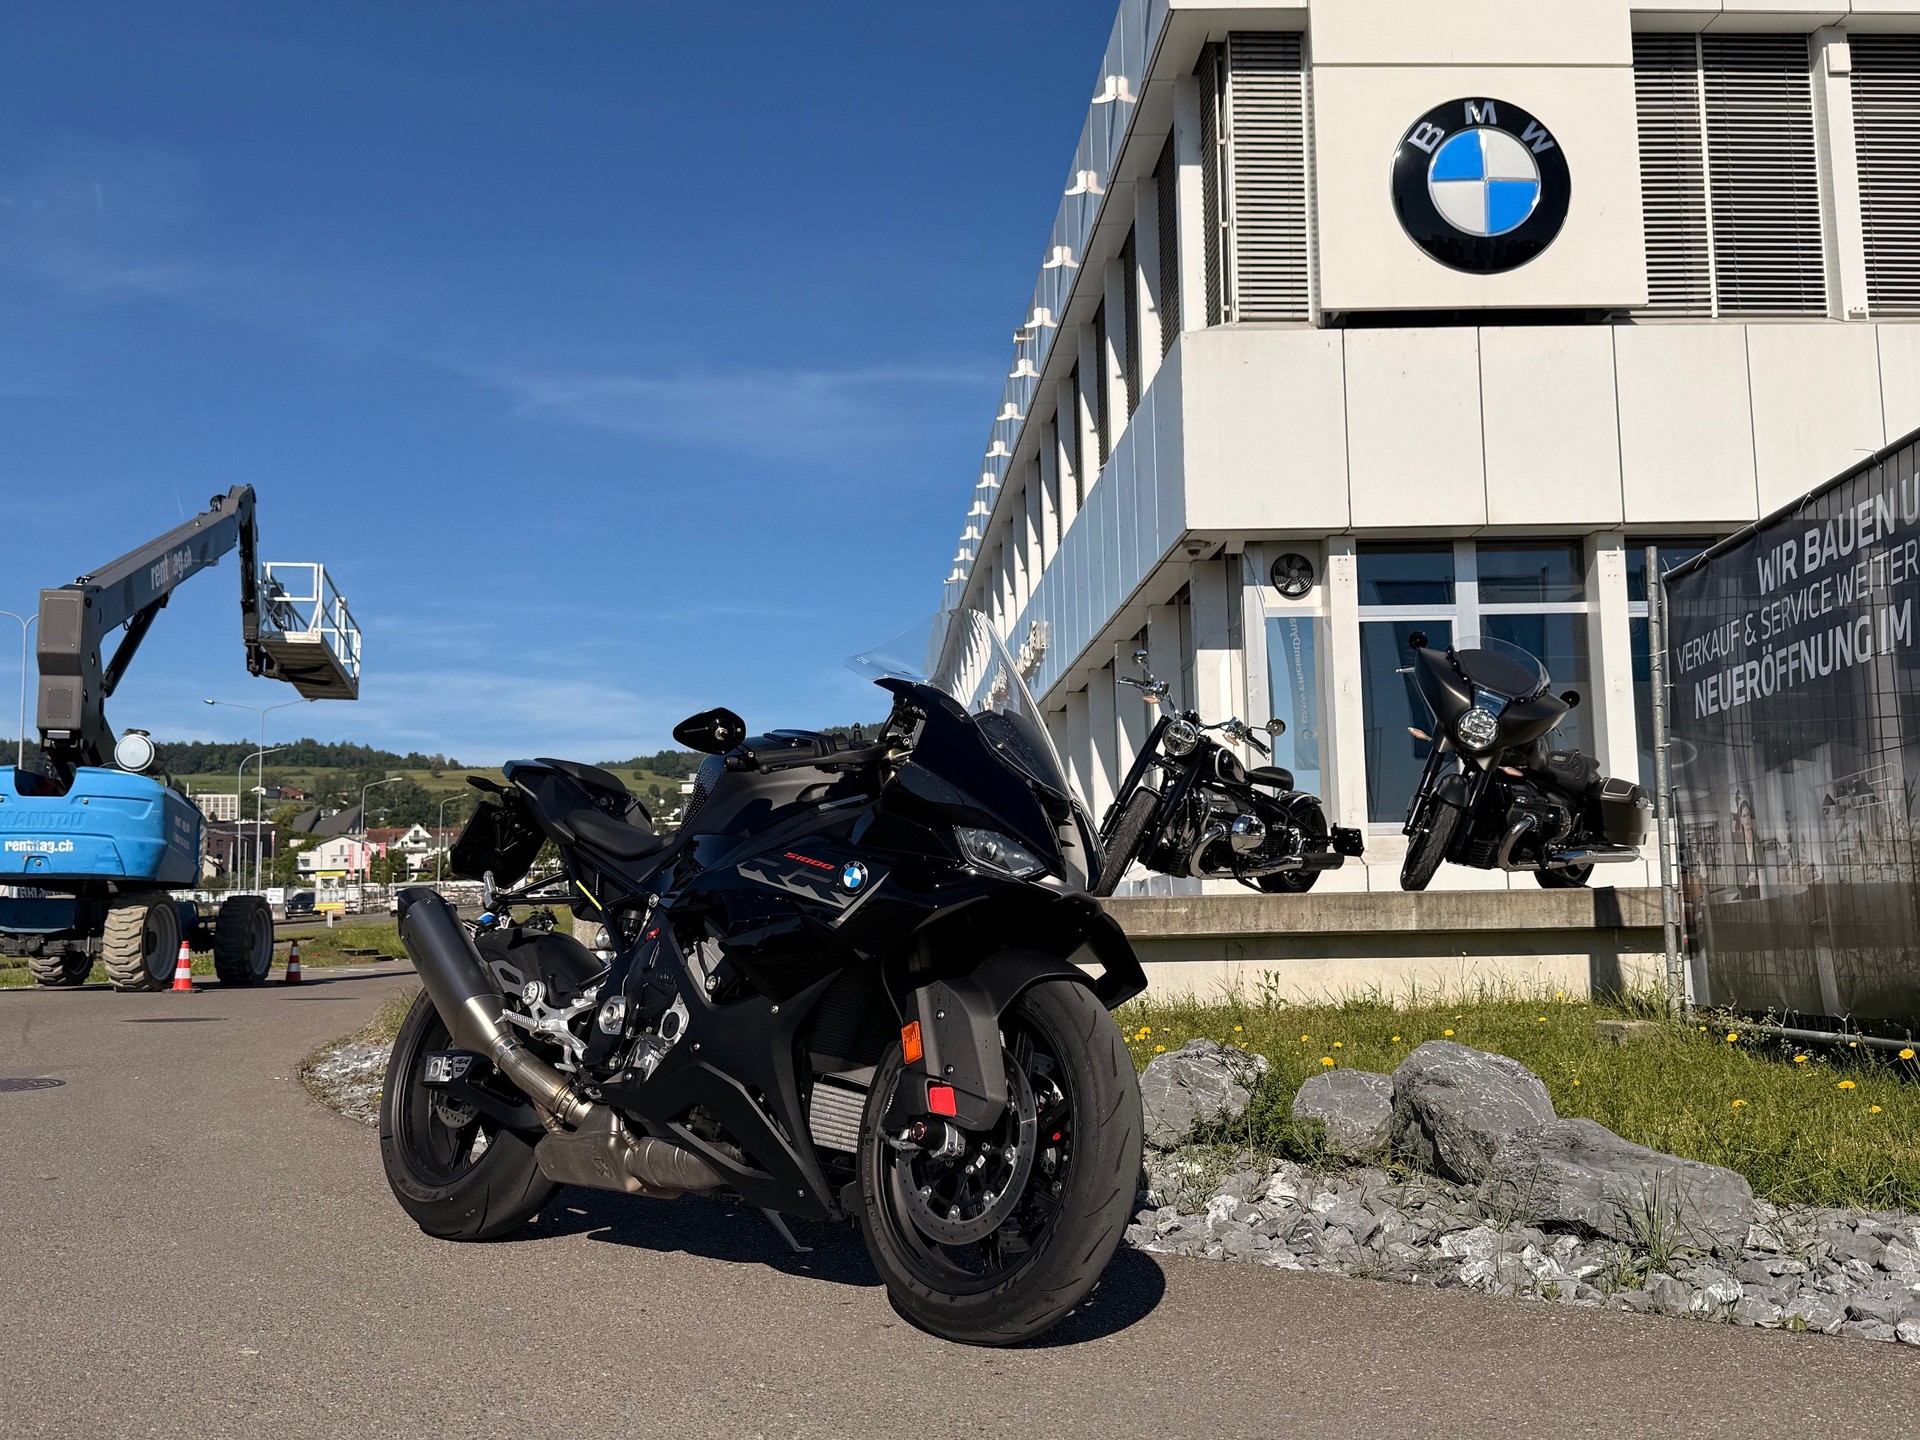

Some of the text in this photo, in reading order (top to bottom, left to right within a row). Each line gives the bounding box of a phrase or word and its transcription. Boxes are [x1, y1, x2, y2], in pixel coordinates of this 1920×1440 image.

[1408, 100, 1555, 155] BMW
[1757, 538, 1798, 596] WIR
[1804, 487, 1895, 575] BAUEN
[1676, 538, 1920, 675] VERKAUF & SERVICE WEITER
[1694, 598, 1912, 719] NEUERÖFFNUNG IM
